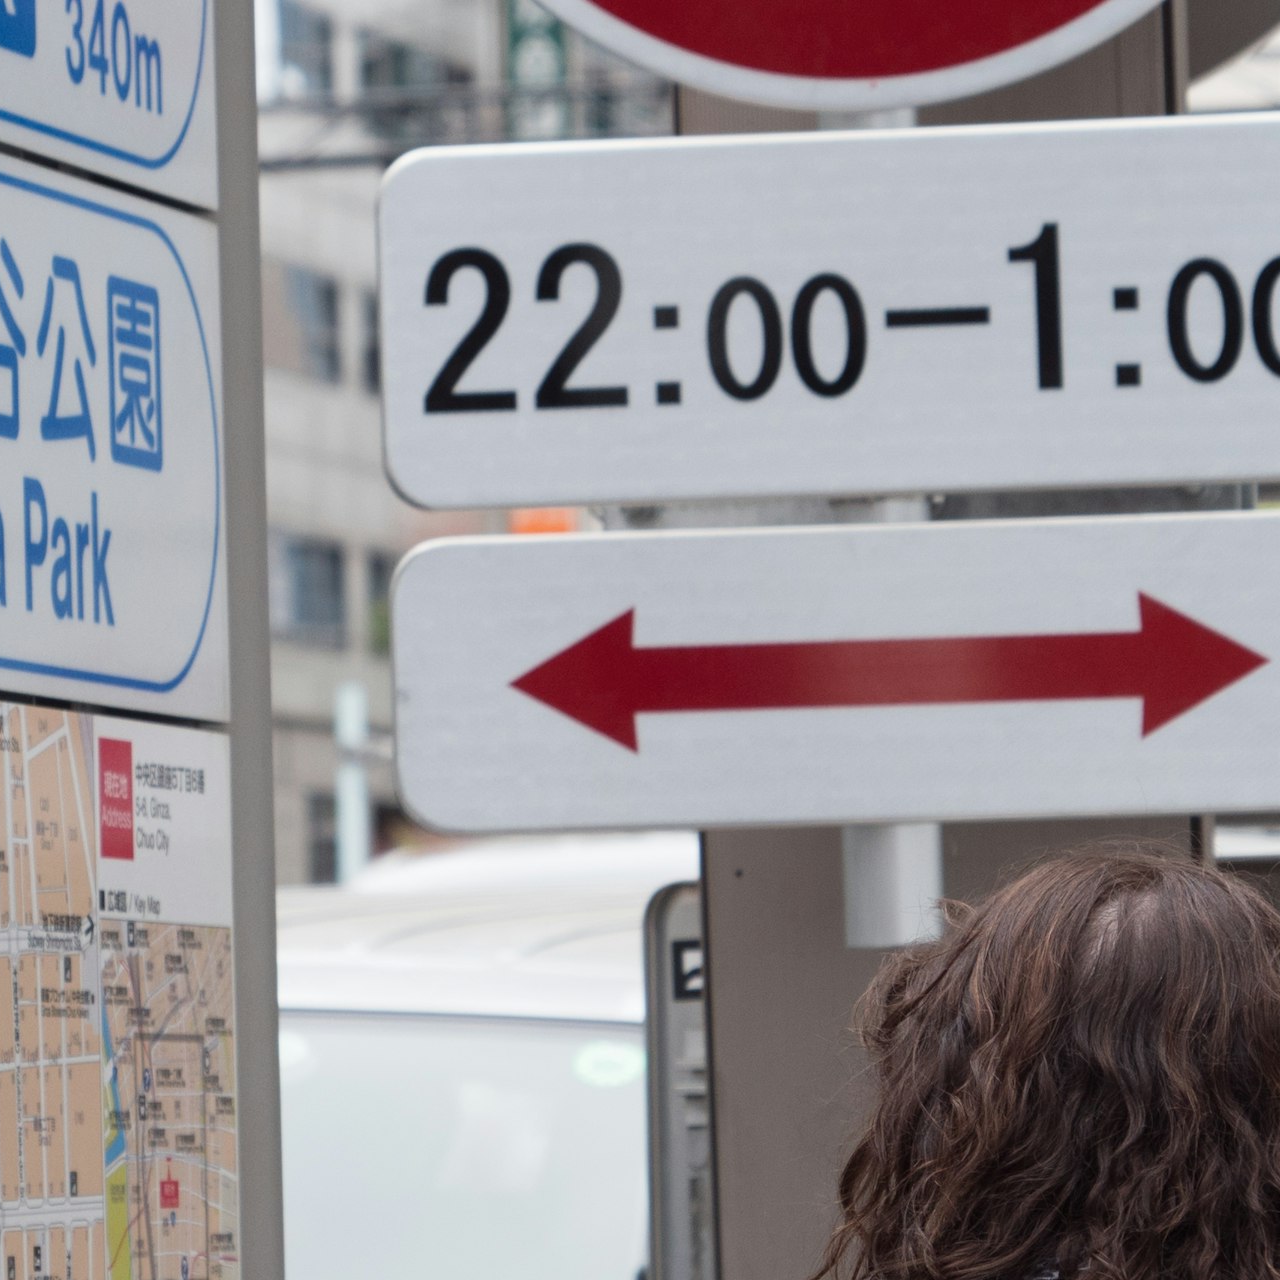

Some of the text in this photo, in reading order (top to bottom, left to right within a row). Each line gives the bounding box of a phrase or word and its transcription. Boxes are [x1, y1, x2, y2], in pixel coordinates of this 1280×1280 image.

[65, 0, 163, 116] 340m
[25, 478, 116, 627] Park
[102, 805, 131, 829] Address
[136, 829, 170, 857] Chuo City
